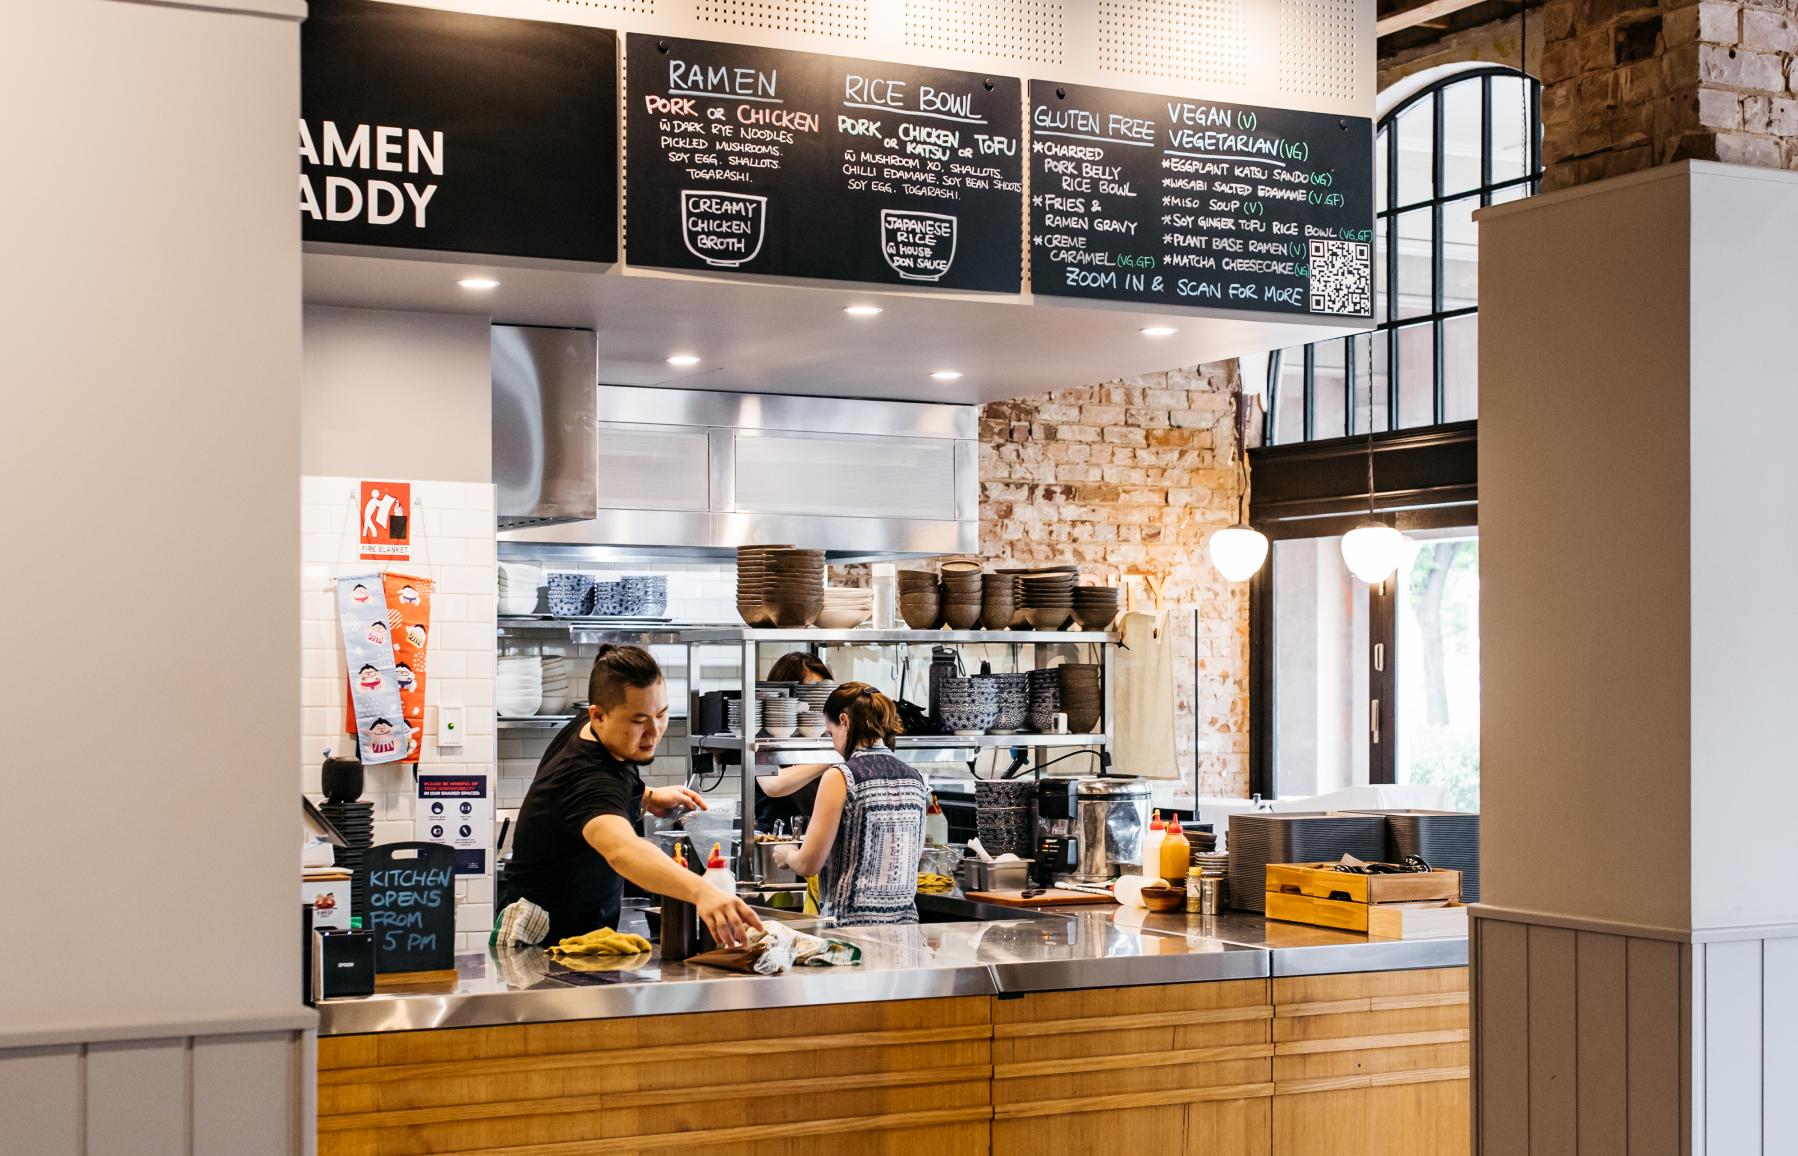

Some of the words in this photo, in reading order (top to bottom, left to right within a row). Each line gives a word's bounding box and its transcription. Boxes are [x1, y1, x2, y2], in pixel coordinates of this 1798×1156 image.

[669, 59, 777, 97] RAMEN
[845, 74, 906, 106] RICE
[919, 86, 982, 119] BOWL
[645, 95, 698, 117] PORK
[707, 108, 726, 120] OR
[737, 105, 819, 133] CHICKEN
[1034, 105, 1100, 135] GLUTEN
[1108, 114, 1155, 140] FREE
[1167, 102, 1232, 128] VEGAN
[1237, 110, 1257, 131] (V)
[661, 136, 708, 149] PICKLED
[673, 121, 705, 134] DARK
[711, 124, 734, 136] RYE
[740, 127, 794, 144] NOODLES
[837, 115, 882, 139] PORK
[884, 138, 899, 149] OR
[899, 123, 960, 149] CHICKEN
[958, 148, 974, 158] OR
[974, 134, 1016, 156] TOFU
[906, 141, 950, 161] KATSU
[1168, 129, 1279, 157] VEGETARIAN
[1279, 138, 1308, 162] (VG)
[668, 152, 690, 163] SOY
[860, 151, 920, 169] MUSHROOM
[842, 164, 876, 177] CHILLI
[942, 175, 962, 187] SOY
[966, 177, 989, 190] BEAN
[993, 179, 1022, 193] SHOOTS
[1044, 158, 1078, 175] PORK
[1082, 163, 1121, 181] BELLY
[1234, 165, 1268, 180] KATSU
[1272, 168, 1309, 184] SANDO
[1310, 171, 1333, 187] (VG)
[848, 179, 868, 191] SOY
[1062, 176, 1092, 193] RICE
[1099, 181, 1138, 197] BOWL
[1212, 181, 1252, 196] SALTED
[1257, 185, 1307, 201] EDAMAME
[688, 197, 757, 218] CREAMY
[1091, 200, 1102, 212] &
[1209, 199, 1240, 212] SOUP
[1243, 201, 1264, 215] (V)
[688, 217, 751, 234] CHICKEN
[885, 216, 951, 237] JAPANESE
[1045, 213, 1089, 230] RAMEN
[1093, 218, 1138, 236] GRAVY
[1198, 216, 1235, 230] GINGER
[1238, 219, 1266, 232] TOFU
[1272, 221, 1299, 236] RICE
[1304, 224, 1337, 238] BOWL
[697, 234, 745, 253] BROTH
[897, 231, 937, 246] RICE
[1212, 238, 1244, 252] BASE
[1248, 240, 1288, 256] RAMEN
[1289, 241, 1306, 260] (V)
[899, 243, 933, 257] HOUSE
[1050, 249, 1116, 266] CARAMEL
[893, 256, 914, 268] DON
[917, 258, 948, 270] SAUCE
[1222, 257, 1294, 275] CHEESECAKE
[1066, 266, 1117, 289] ZOOM
[1125, 273, 1144, 292] IN
[1151, 275, 1164, 293] &
[1177, 278, 1221, 298] SCAN
[1228, 283, 1259, 299] FOR
[1264, 286, 1304, 306] MORE
[370, 866, 452, 888] KITCHEN
[370, 890, 442, 907] OPENS
[369, 910, 423, 930] FROM
[382, 930, 403, 951] 5
[407, 933, 436, 951] PM
